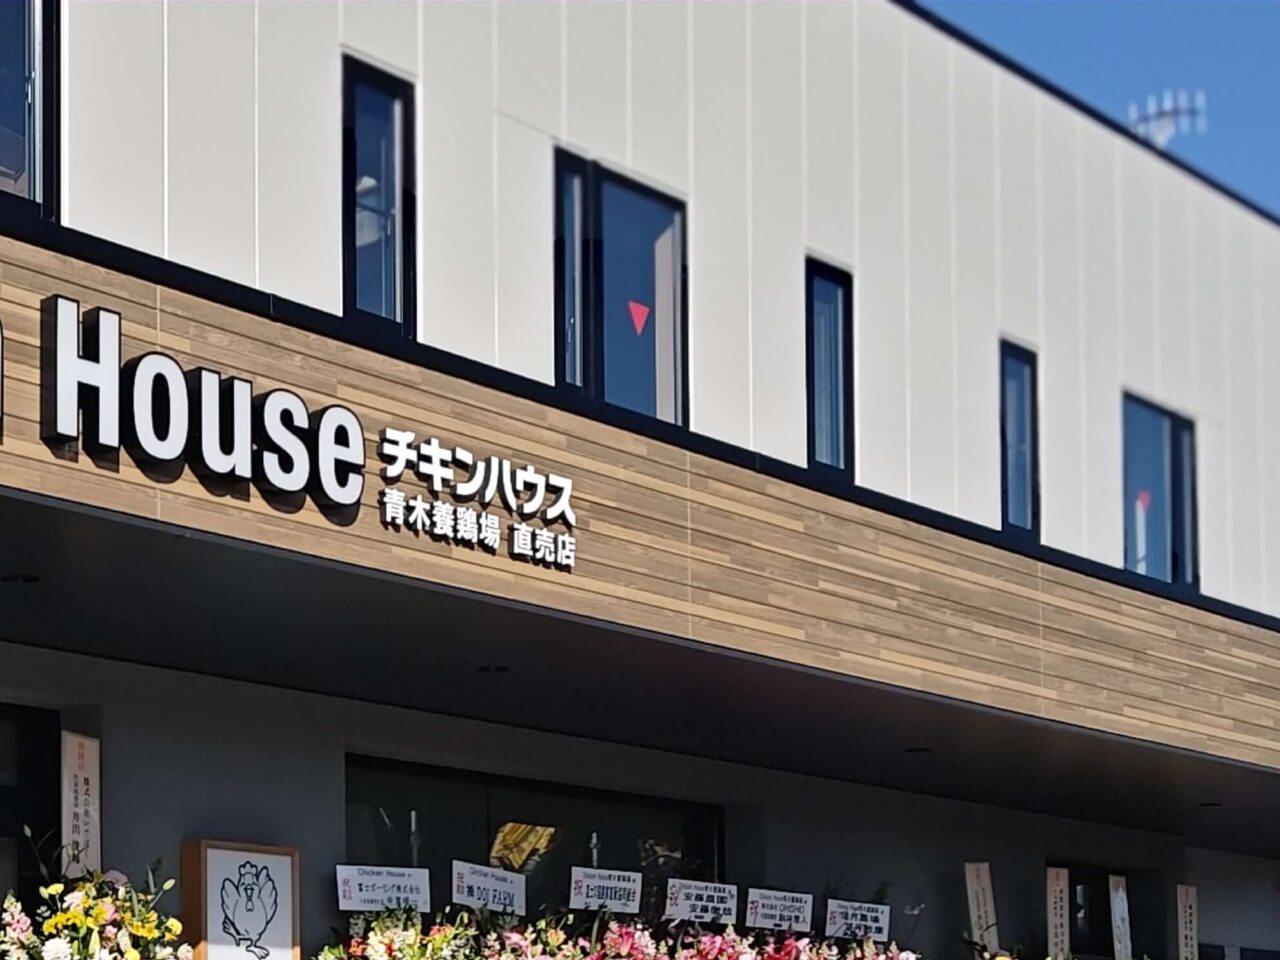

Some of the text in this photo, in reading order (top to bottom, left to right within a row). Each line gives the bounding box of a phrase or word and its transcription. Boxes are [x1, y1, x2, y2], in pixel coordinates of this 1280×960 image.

[49, 294, 368, 508] House
[381, 427, 577, 527] チキンハウス
[382, 487, 577, 567] 青木養鶏場 直売店
